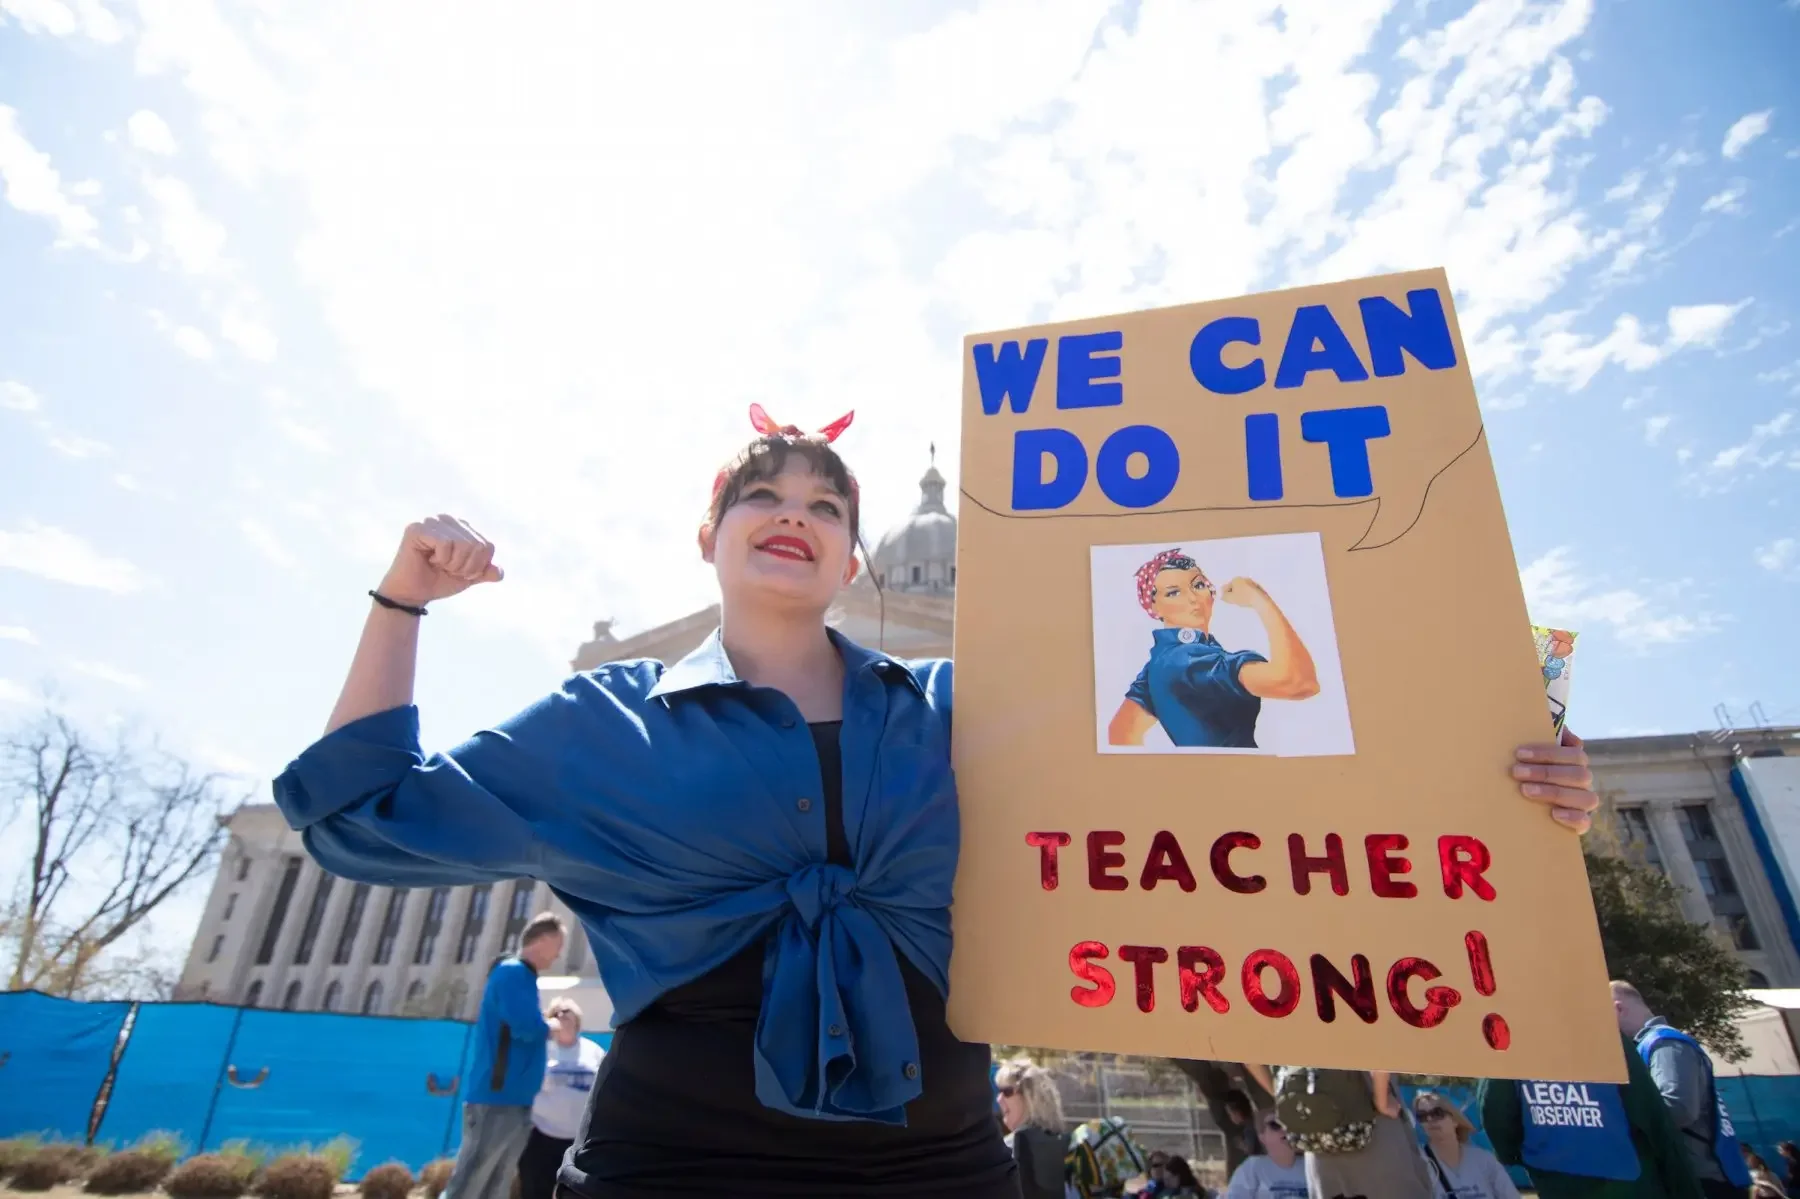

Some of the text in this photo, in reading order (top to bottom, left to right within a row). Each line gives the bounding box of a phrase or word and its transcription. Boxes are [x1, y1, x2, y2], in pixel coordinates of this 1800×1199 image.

[973, 288, 1457, 415] WE CAN
[1011, 405, 1391, 511] DO IT
[1024, 830, 1497, 903] TEACHER
[1068, 930, 1511, 1051] STRONG!
[1521, 1083, 1600, 1107] LEGAL
[1530, 1105, 1604, 1128] OBSERVER
